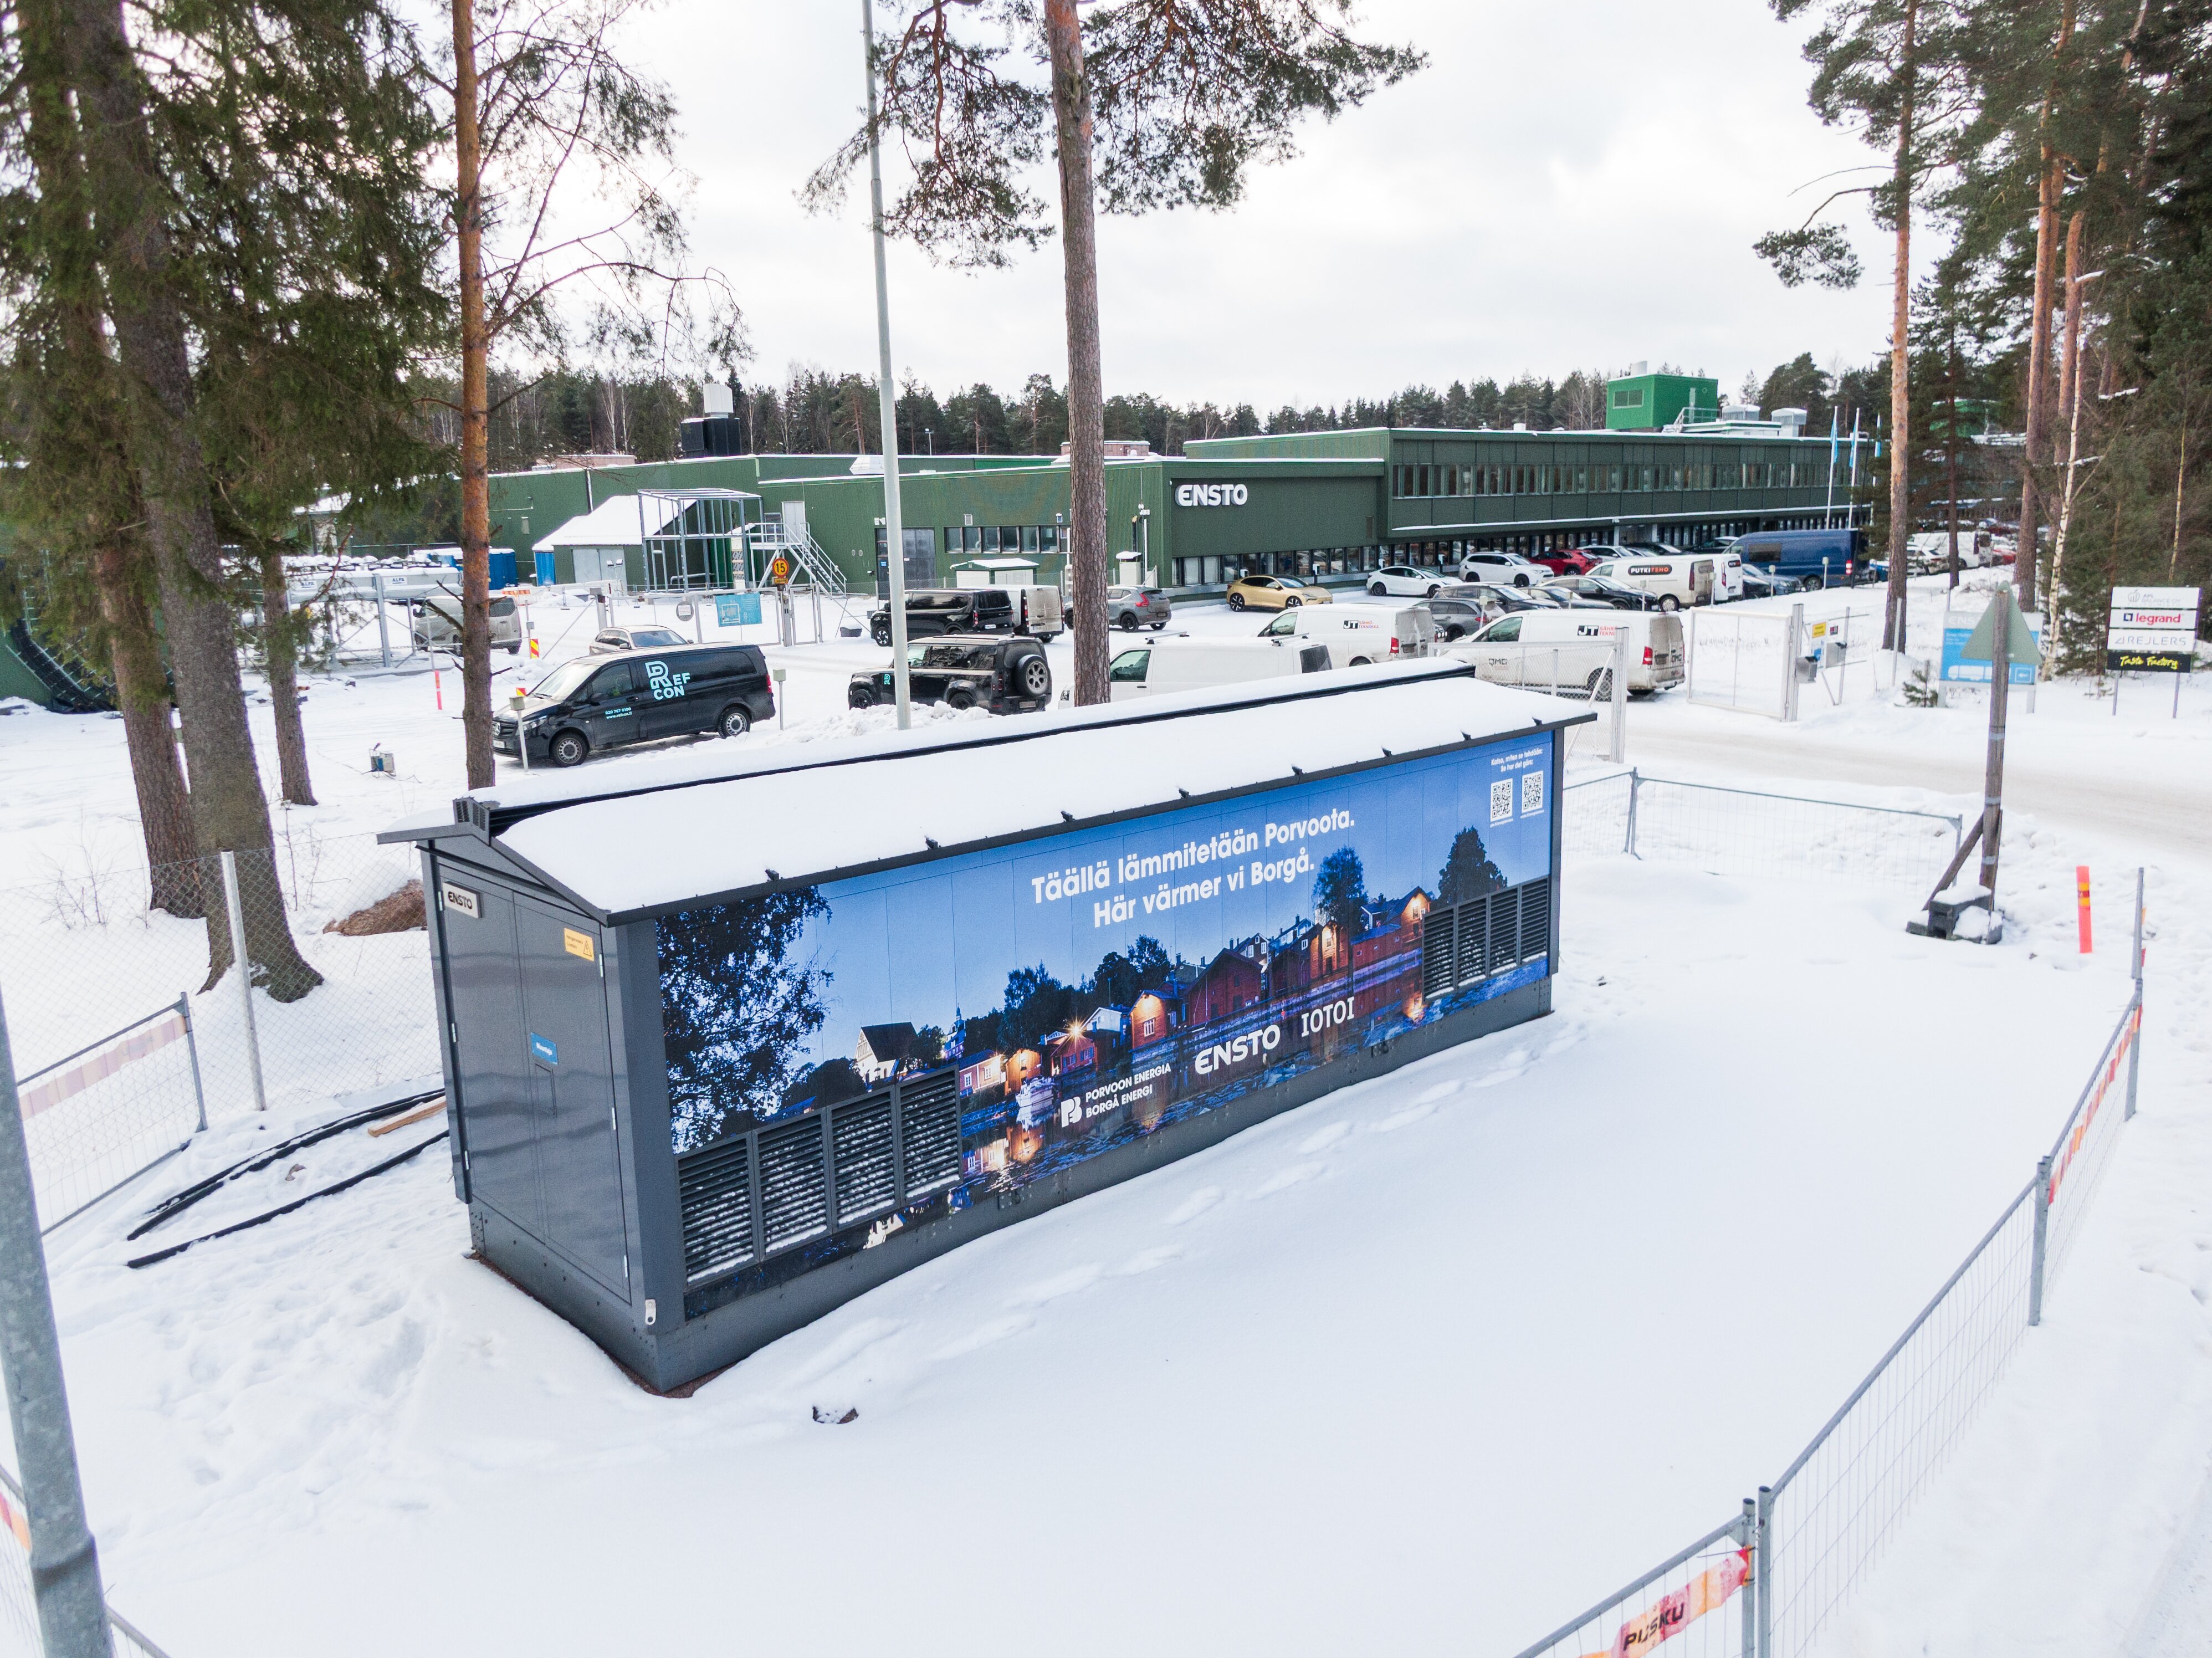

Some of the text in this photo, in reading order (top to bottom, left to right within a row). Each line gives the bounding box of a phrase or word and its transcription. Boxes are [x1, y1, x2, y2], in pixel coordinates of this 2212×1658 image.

[1176, 484, 1248, 506] ENSTO
[776, 562, 785, 573] 15
[2136, 612, 2181, 625] legrand
[1579, 626, 1599, 635] JT
[2127, 636, 2187, 646] REJLERS
[2120, 656, 2179, 670] Taste Factory
[1032, 808, 1355, 904] Täällä lämmitetään Porvoota.
[1094, 848, 1314, 928] Här värmer vi Borgå.
[448, 891, 473, 909] ENSTO
[1195, 1024, 1280, 1075] ENSTO
[1085, 1063, 1171, 1103] PORVOON ENERGIA
[1086, 1084, 1153, 1118] BORGÅ ENERGI
[1623, 1603, 1685, 1651] PUSKU
